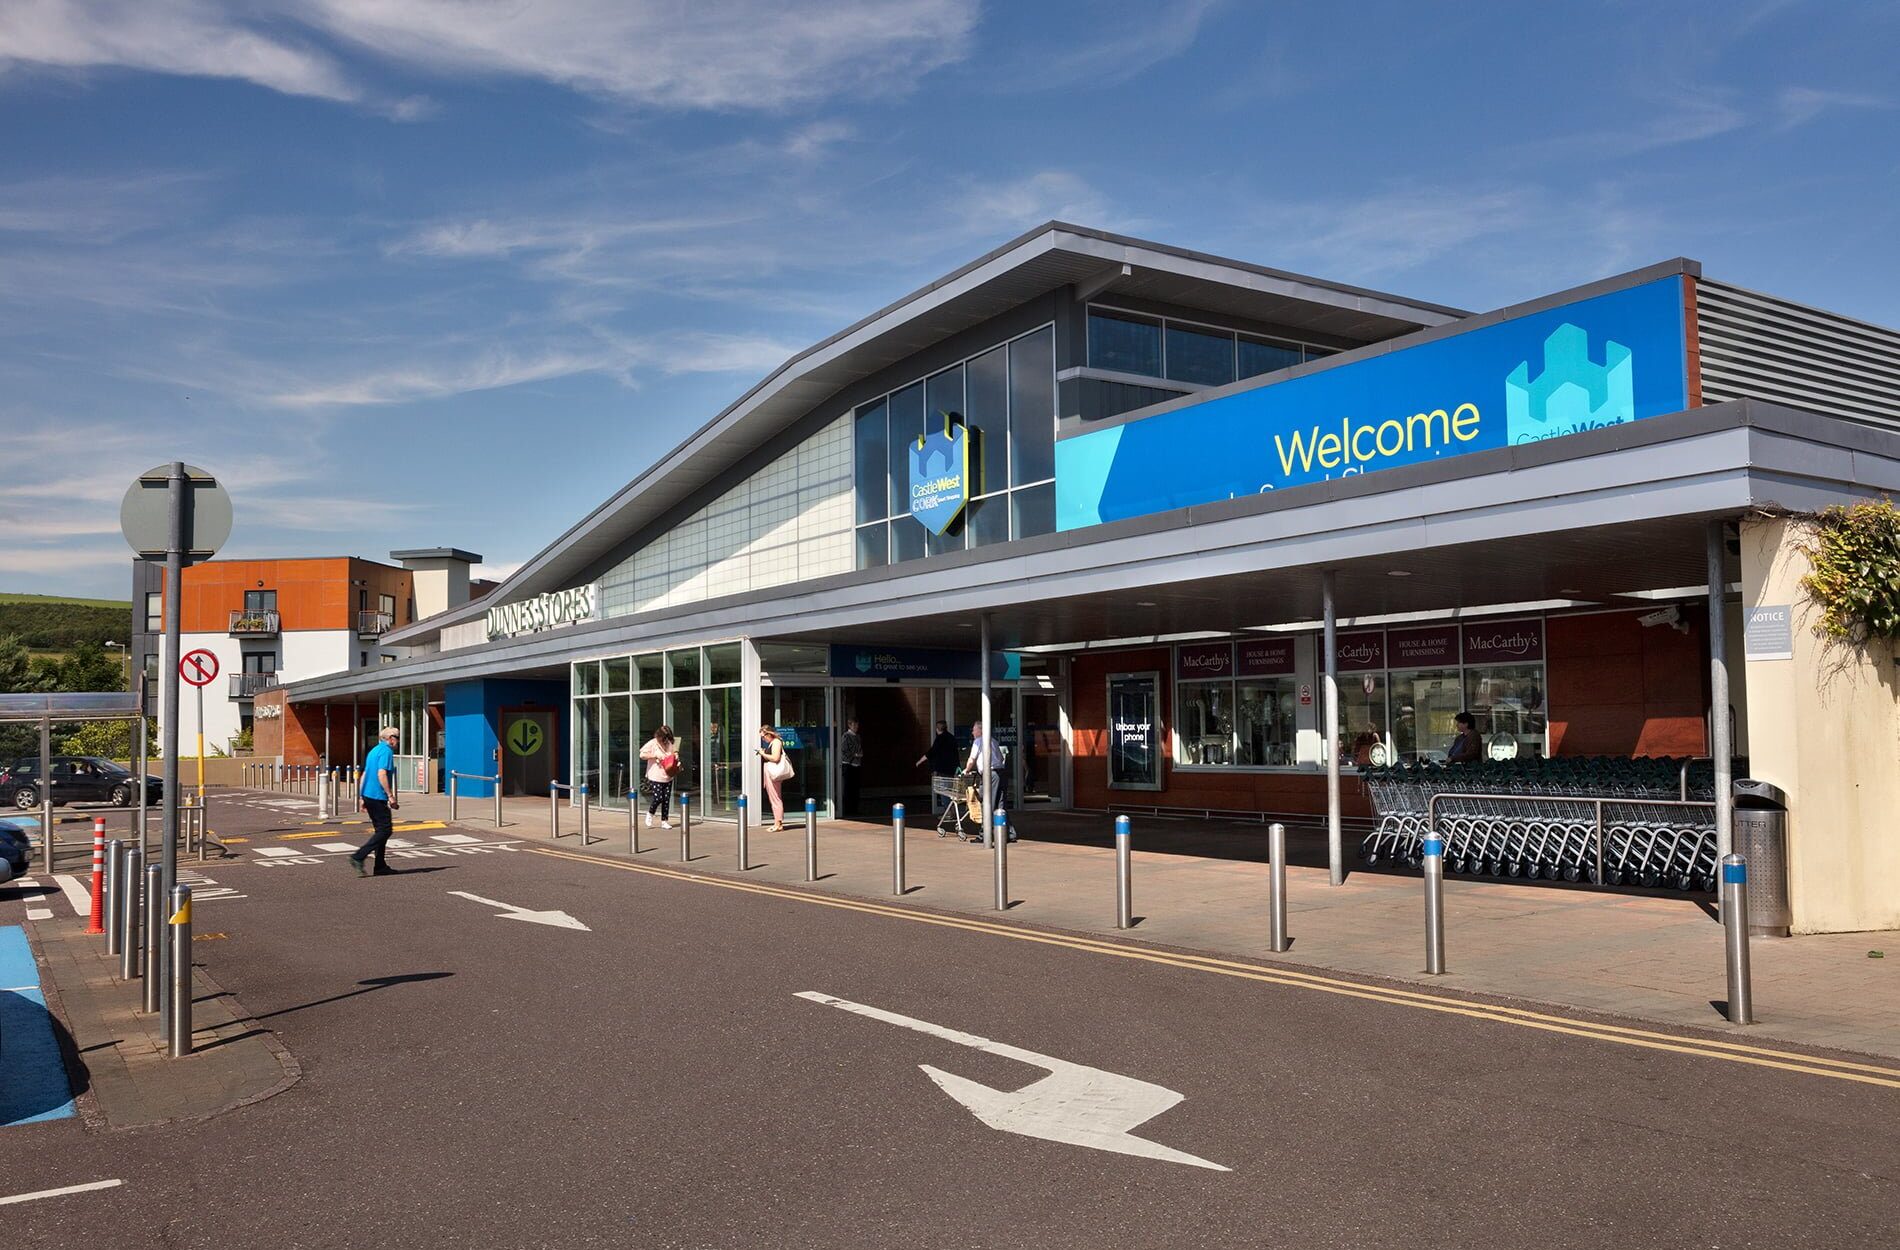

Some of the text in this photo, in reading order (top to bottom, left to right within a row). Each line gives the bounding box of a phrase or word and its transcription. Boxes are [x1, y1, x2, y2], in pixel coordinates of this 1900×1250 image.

[1274, 402, 1481, 476] Welcome
[487, 585, 590, 637] DUNNES STORES
[1750, 611, 1785, 622] NOTICE
[1399, 640, 1421, 649] HOUSE
[1428, 638, 1448, 647] HOME
[1469, 632, 1538, 655] MacCarthy's
[1336, 643, 1380, 663] cCarthy's
[1402, 647, 1445, 657] FURNISHINGS
[1183, 652, 1230, 671] MacCarthy's
[1115, 723, 1151, 733] Unbox your
[1124, 732, 1144, 743] phone
